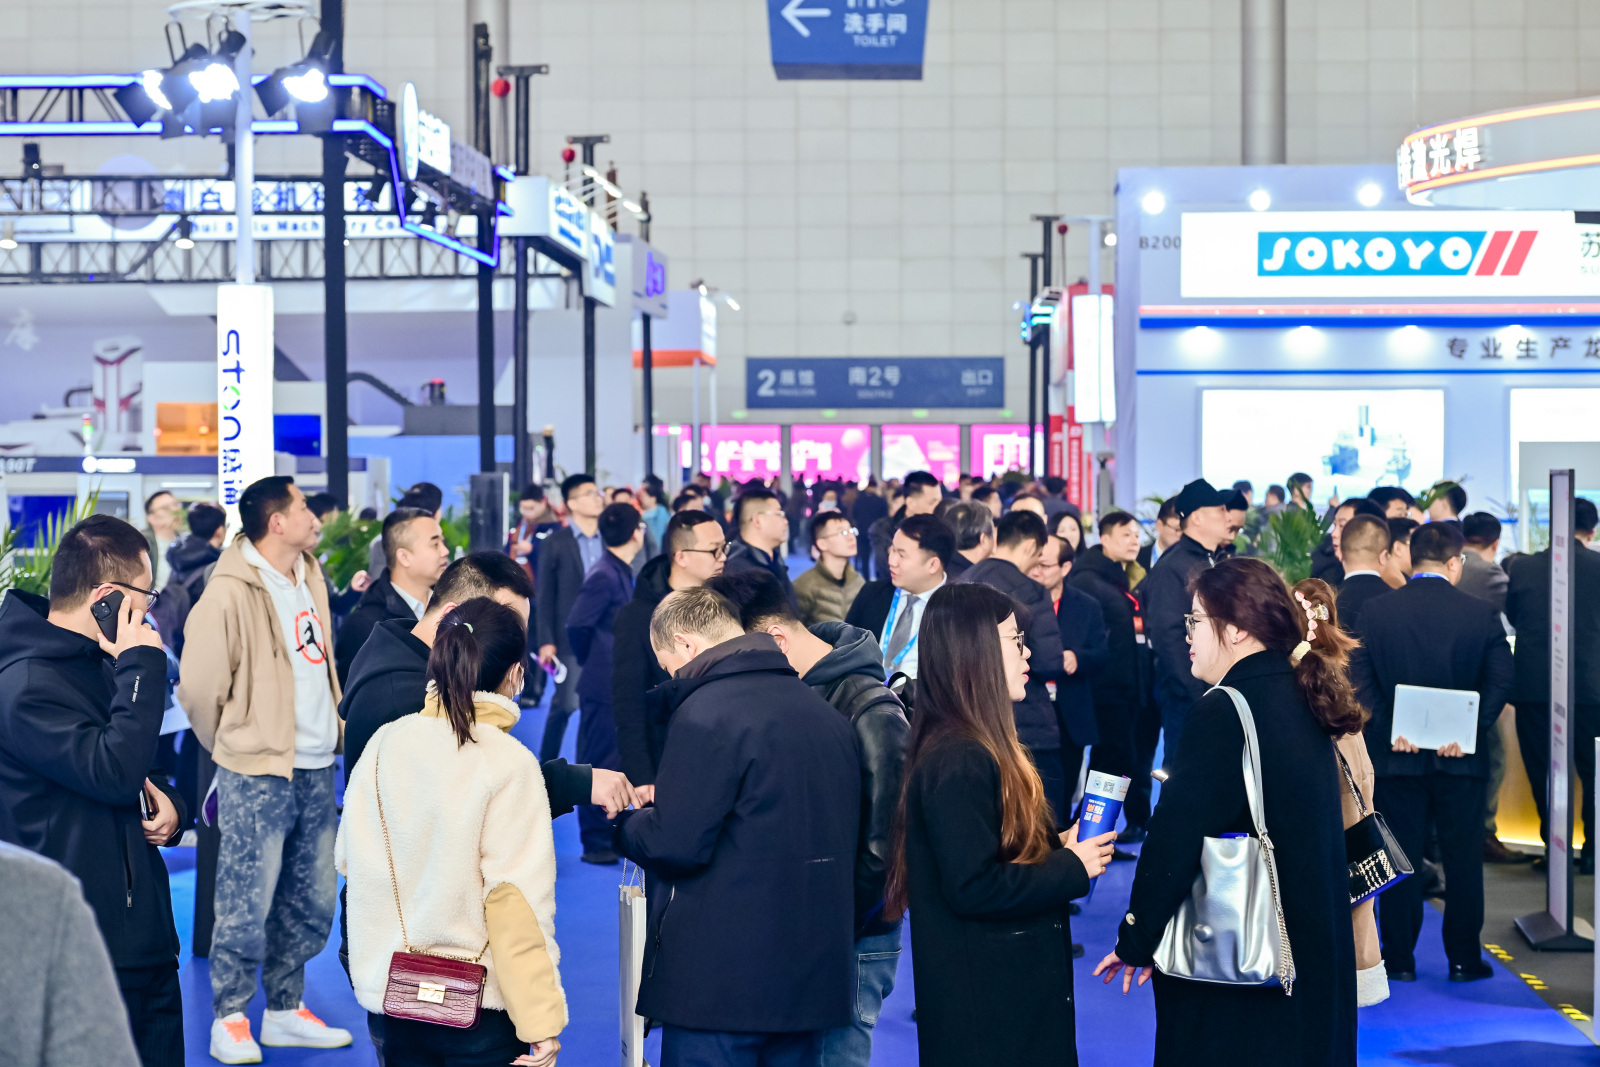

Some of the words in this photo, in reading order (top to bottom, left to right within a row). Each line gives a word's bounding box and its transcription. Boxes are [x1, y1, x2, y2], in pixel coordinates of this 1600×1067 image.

[843, 12, 908, 34] 洗手间
[853, 34, 897, 47] TOILET
[1262, 236, 1473, 271] SOKOYO
